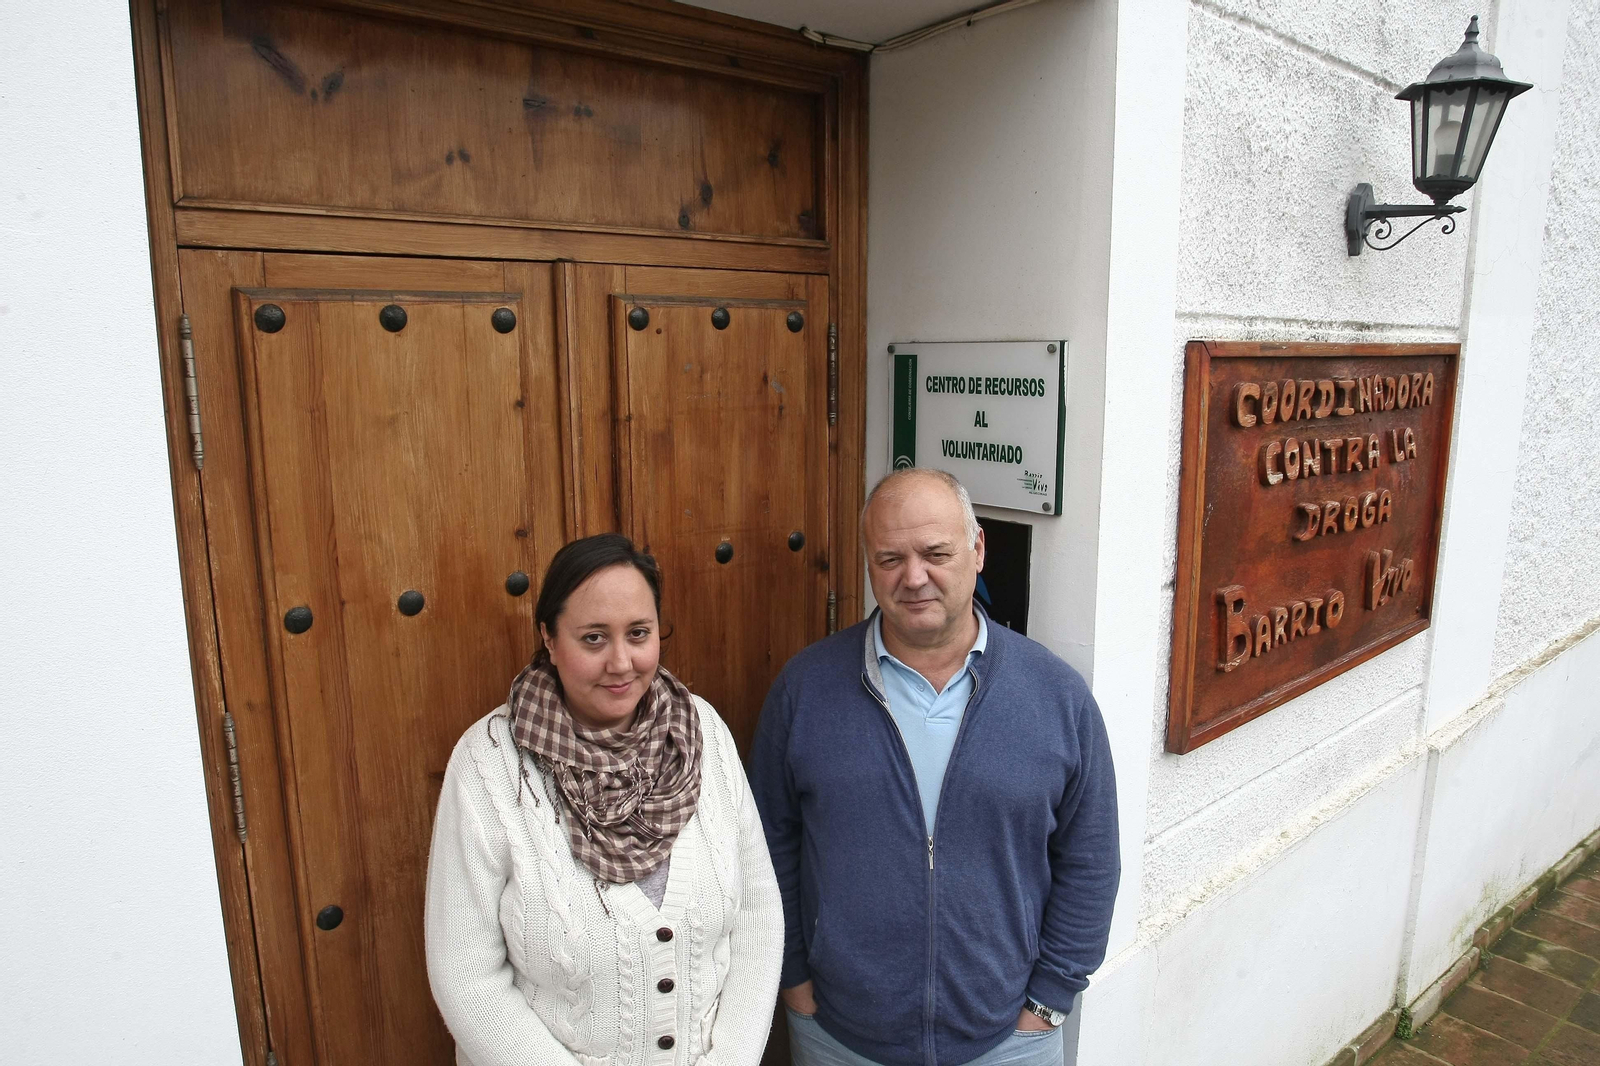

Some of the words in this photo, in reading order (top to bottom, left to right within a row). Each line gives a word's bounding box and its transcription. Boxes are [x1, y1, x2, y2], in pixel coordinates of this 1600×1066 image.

[926, 376, 966, 395] CENTRO
[968, 378, 982, 394] DE
[985, 377, 1045, 397] RECURSOS
[1236, 372, 1434, 428] COORDINADORA
[974, 411, 988, 427] AL
[941, 439, 1023, 464] VOLUNTARIADO
[1263, 432, 1380, 485] CONTRA
[1391, 426, 1417, 462] LA
[1294, 489, 1391, 541] DROGA
[1219, 585, 1344, 672] BARRIO
